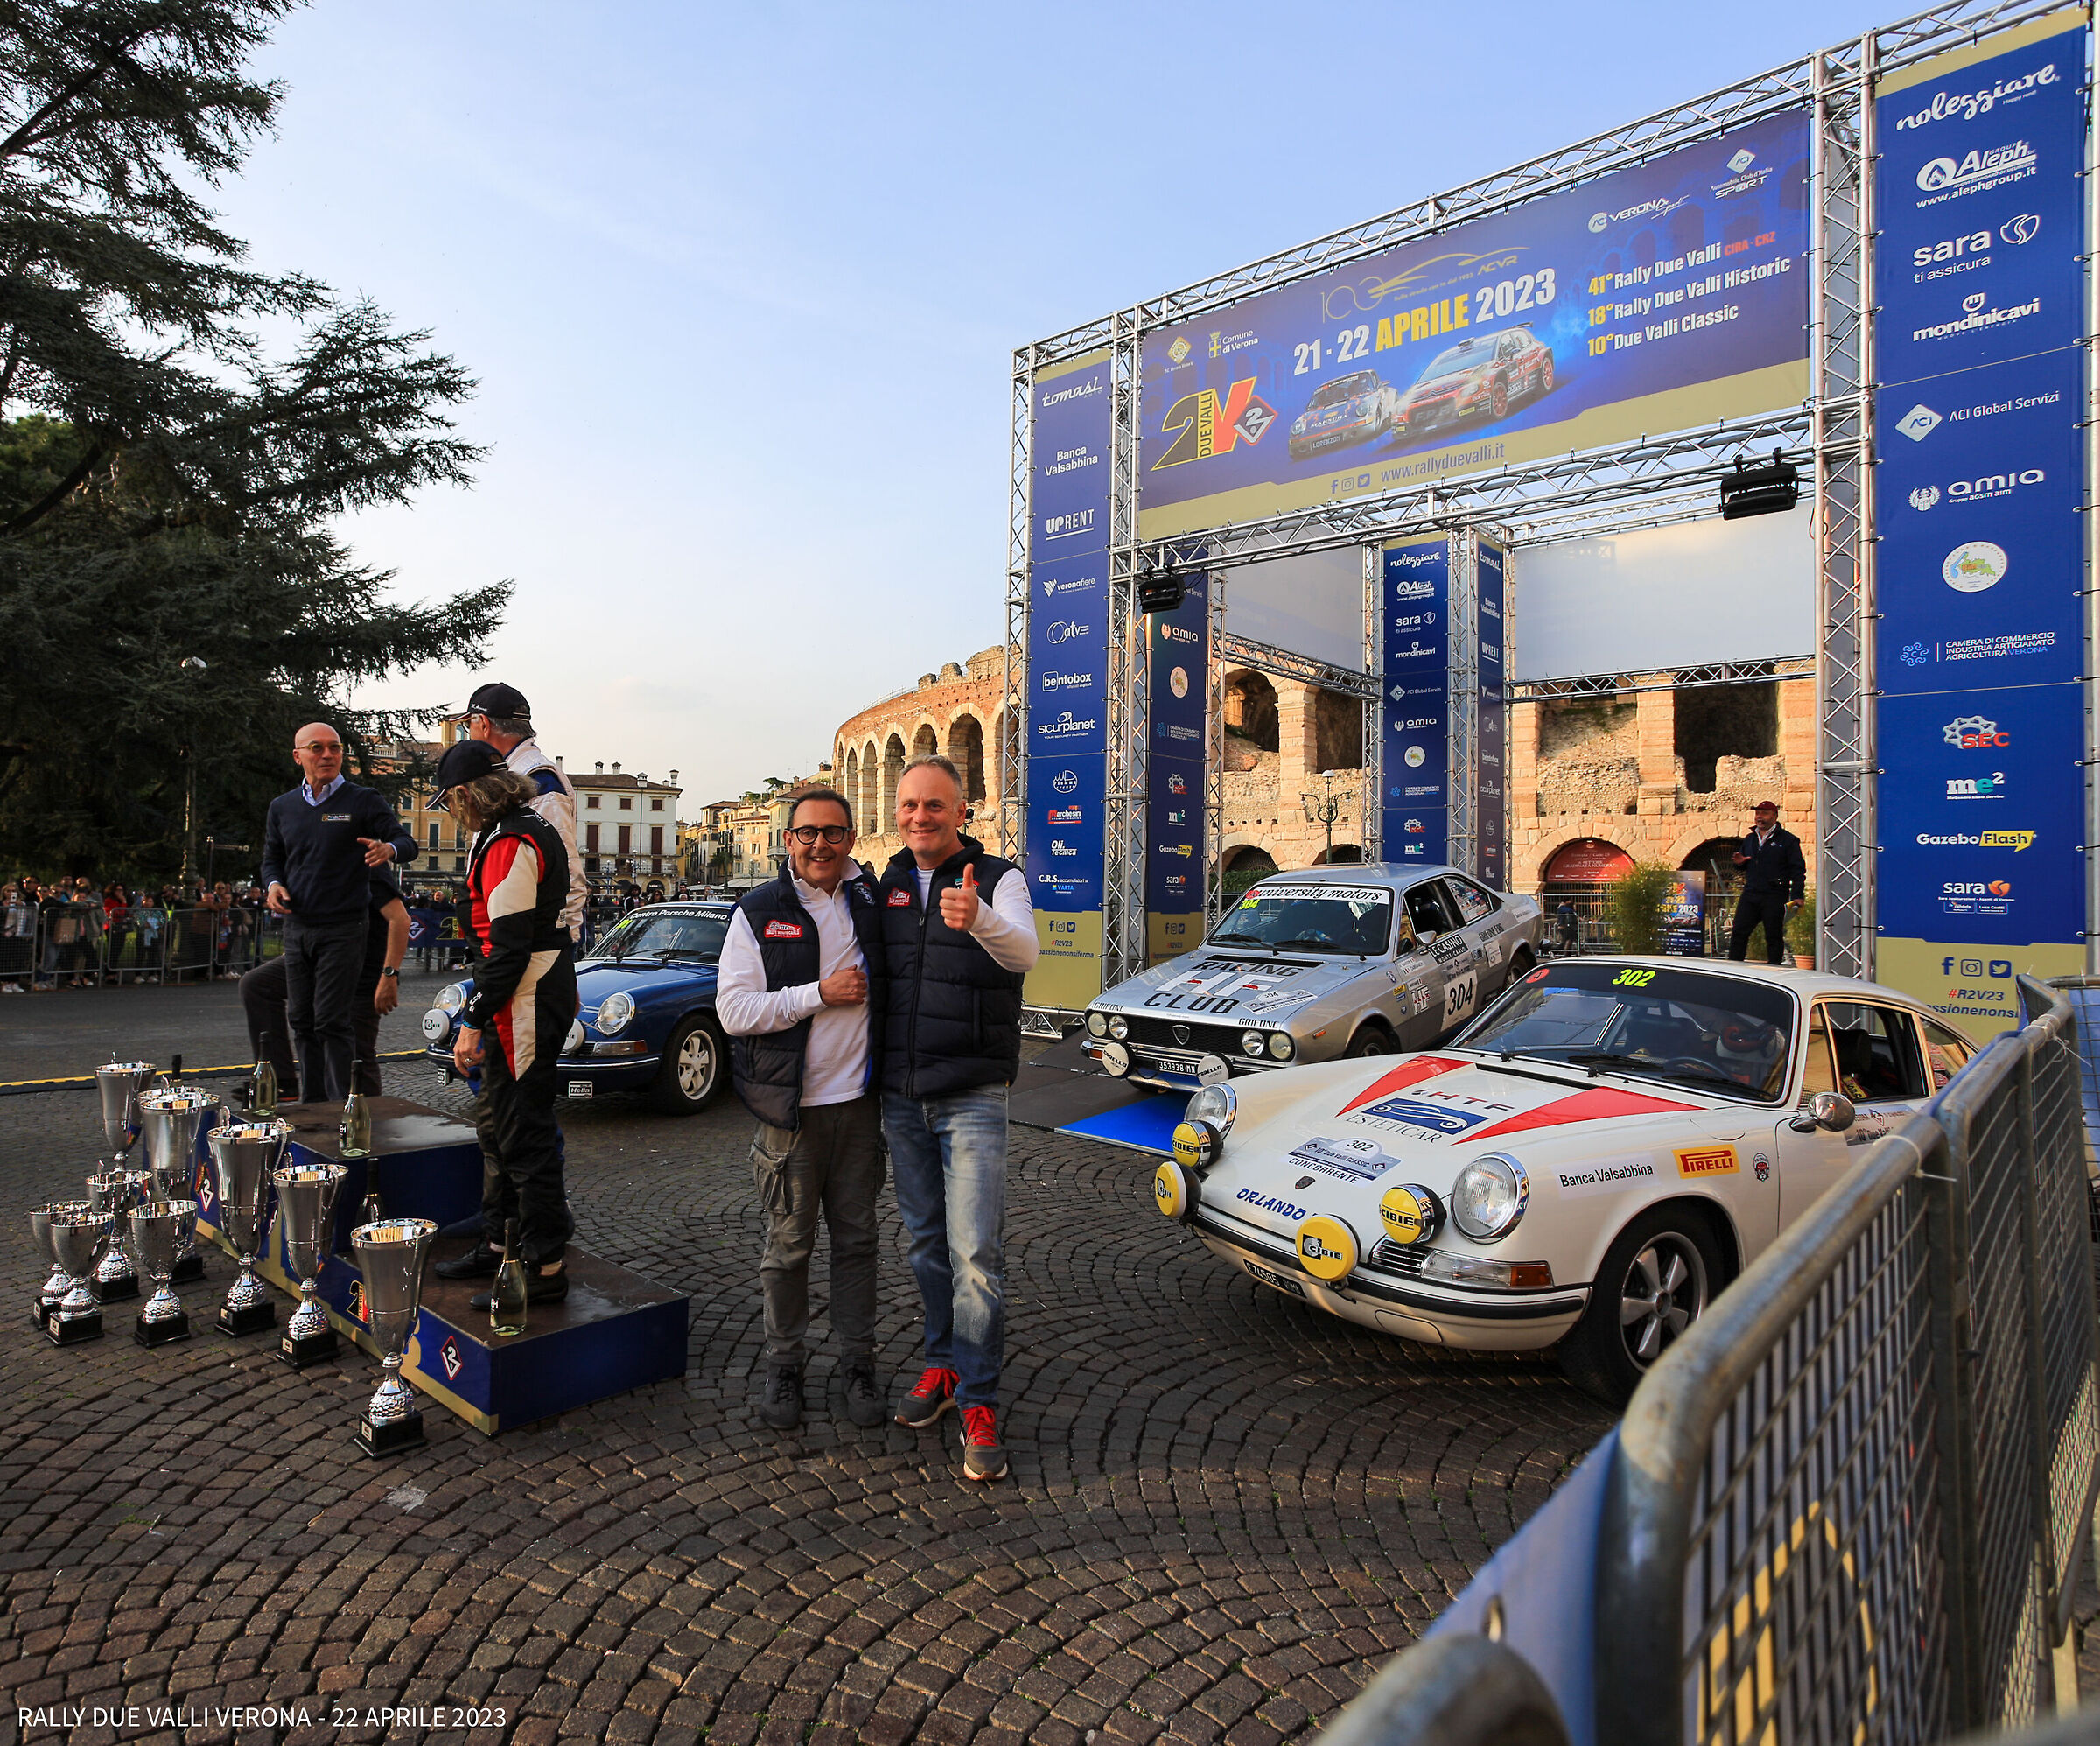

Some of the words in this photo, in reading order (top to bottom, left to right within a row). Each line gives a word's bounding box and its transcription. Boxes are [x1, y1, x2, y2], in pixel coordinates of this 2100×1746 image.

[1896, 63, 2054, 130] noleggiare
[1956, 140, 2028, 178] Aleph
[1710, 178, 1740, 191] Automobile
[1740, 172, 1754, 182] Club
[1916, 166, 2036, 209] www.alephgroup.it
[1608, 197, 1670, 221] VERONA
[1913, 230, 1991, 267] sara
[1614, 266, 1652, 289] Rally
[1655, 256, 1684, 277] Due
[1686, 242, 1721, 266] Valli
[1754, 231, 1775, 249] CRZ
[1913, 271, 1924, 284] ti
[1927, 256, 1991, 280] assicura
[1614, 296, 1652, 319] Rally
[1655, 287, 1684, 309] Due
[1686, 275, 1721, 298] Valli
[1725, 257, 1791, 289] Historic
[1294, 339, 1321, 376] 21
[1337, 324, 1370, 363] 22
[1375, 293, 1469, 352] APRILE
[1475, 268, 1556, 324] 2023
[1614, 329, 1642, 350] Due
[1645, 319, 1678, 341] Valli
[1681, 305, 1739, 333] Classic
[1913, 298, 2040, 341] mondinicavi
[1222, 330, 1254, 345] Comune
[1222, 344, 1230, 353] di
[1232, 338, 1259, 351] Verona
[1042, 376, 1102, 407] tomasi
[1200, 391, 1213, 426] VALLI
[1949, 408, 1970, 423] ACI
[1973, 401, 2012, 417] Global
[2015, 391, 2060, 410] Servizi
[1200, 426, 1213, 458] DUE
[1056, 446, 1087, 461] Banca
[1381, 443, 1504, 482] www.rallyduevalli.it
[1045, 455, 1098, 476] Valsabbina
[1947, 469, 2045, 496] amia
[1057, 578, 1096, 591] veronafiere
[1396, 615, 1421, 627] sara
[1945, 639, 1983, 648] CAMERA
[1995, 632, 2054, 644] COMMERCIO
[1945, 645, 1993, 655] INDUSTRIA
[1993, 639, 2054, 650] ARTIGIANATO
[1945, 649, 2007, 661] AGRICOLTURA
[2008, 646, 2048, 656] VERONA
[1044, 673, 1092, 687] bentobox
[1038, 718, 1096, 733] sicurplanet
[1962, 733, 2010, 749] SEC
[1916, 833, 1979, 845] Gazebo
[1983, 832, 2028, 844] Flash
[1039, 874, 1060, 883] C.R.S.
[1166, 875, 1179, 884] sara
[1943, 881, 1985, 894] sara
[1239, 899, 1261, 910] 304
[1258, 887, 1324, 899] university
[1328, 890, 1382, 901] motors
[630, 911, 657, 920] Centro
[695, 911, 727, 920] Milano
[1051, 939, 1073, 948] #R2V23
[1192, 961, 1305, 978] RACING
[1612, 969, 1656, 988] 302
[1155, 970, 1287, 998] HF
[1144, 992, 1241, 1014] CLUB
[1448, 978, 1473, 1015] 304
[1948, 989, 2005, 1001] #R2V23
[1158, 1061, 1184, 1072] 353938
[1347, 1114, 1443, 1144] ESTETICAR
[1347, 1140, 1374, 1152] 302
[1289, 1158, 1360, 1184] CONCORRENTE
[1679, 1150, 1734, 1173] PIRELLI
[1559, 1170, 1595, 1188] Banca
[1595, 1163, 1654, 1183] Valsabbina
[1236, 1187, 1306, 1220] ORLANDO
